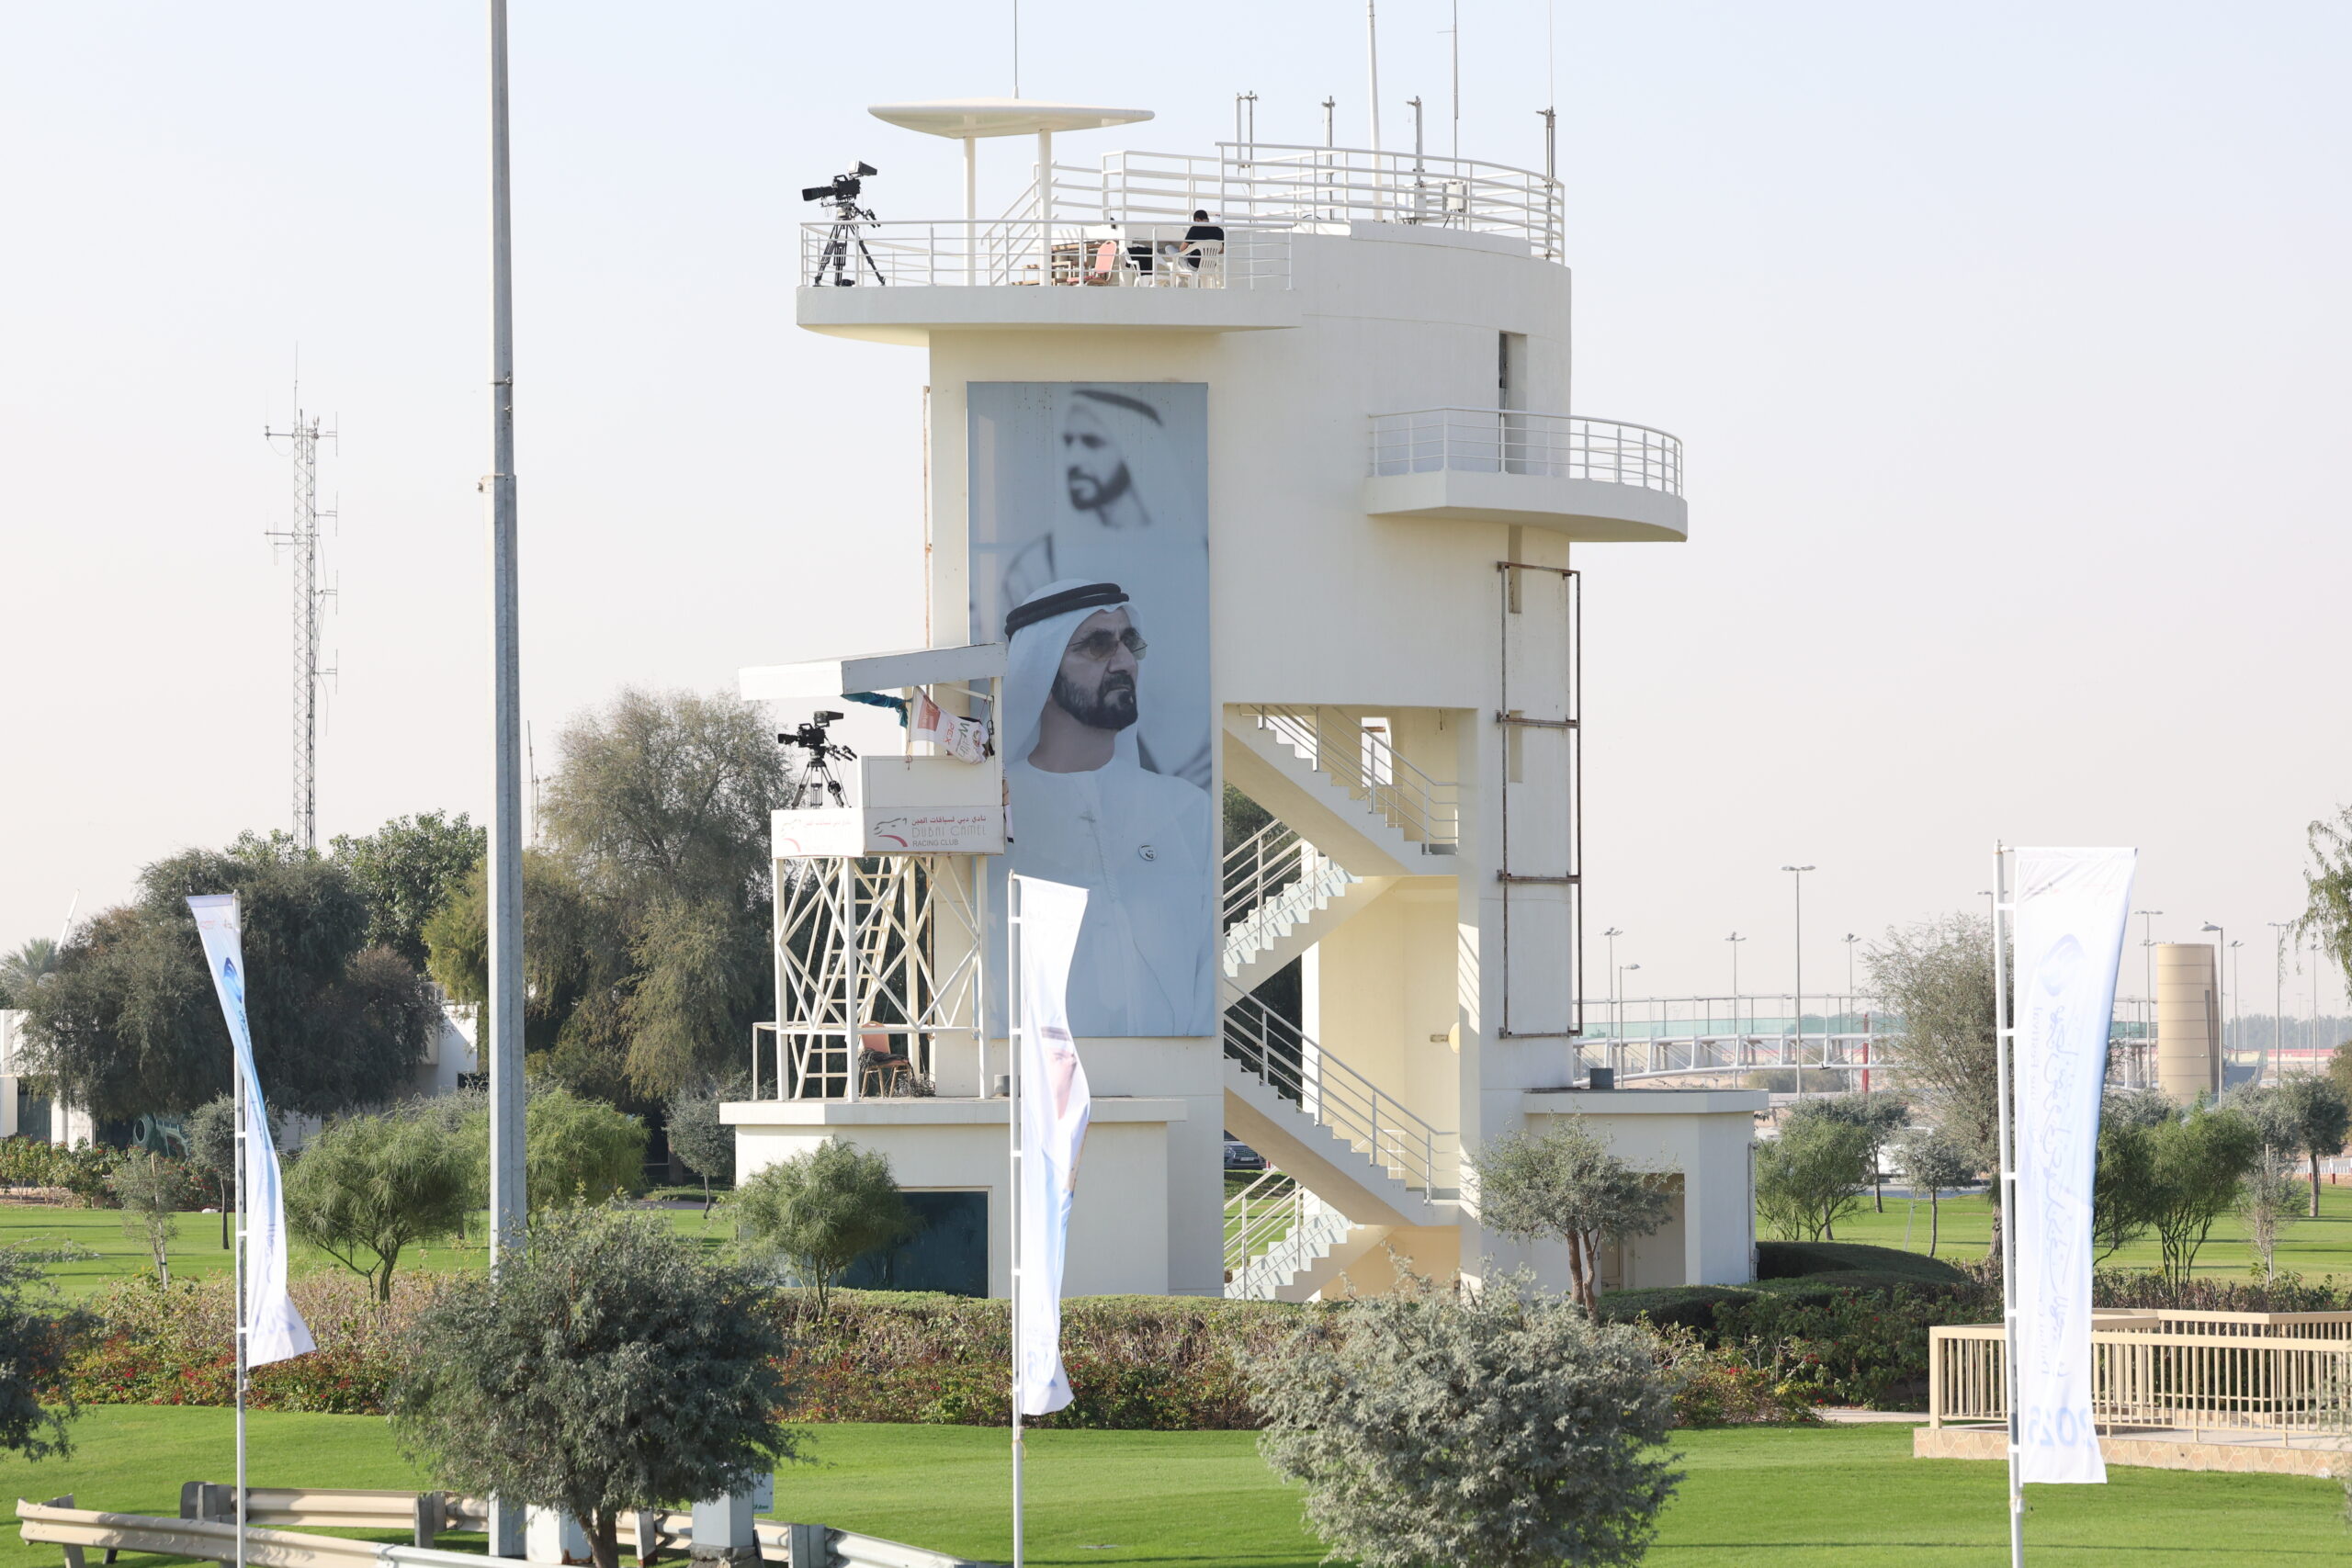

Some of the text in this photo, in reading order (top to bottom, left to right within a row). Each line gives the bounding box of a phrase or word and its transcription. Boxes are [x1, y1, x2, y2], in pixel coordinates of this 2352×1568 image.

[972, 815, 987, 824] نادي
[911, 825, 986, 838] DUBAI CAMEL
[912, 840, 938, 848] RACING
